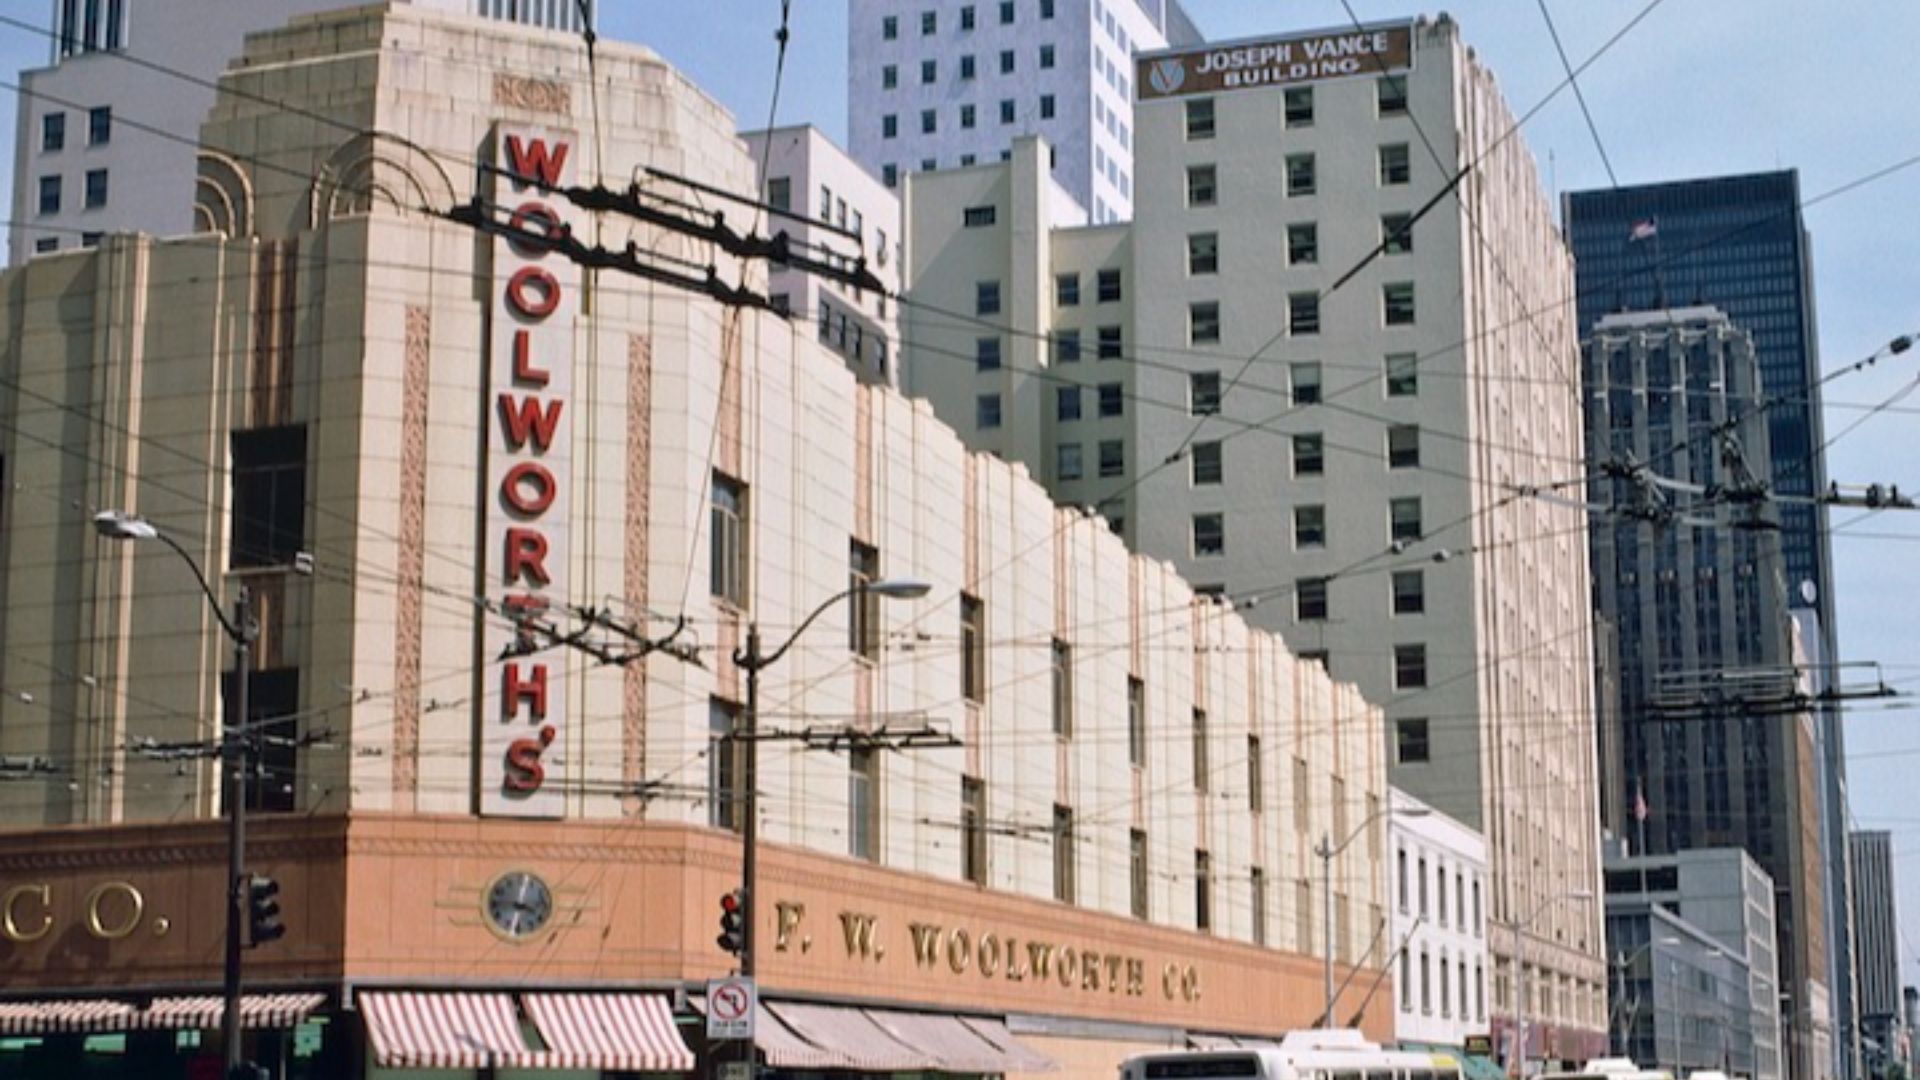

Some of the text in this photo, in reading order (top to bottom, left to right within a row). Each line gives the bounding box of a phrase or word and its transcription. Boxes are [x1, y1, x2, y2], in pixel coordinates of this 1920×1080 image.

[1196, 30, 1389, 74] JOSEPH VANCE
[1223, 57, 1361, 87] BUILDING
[775, 901, 1201, 1001] F. W. WOOLWORTH CO.
